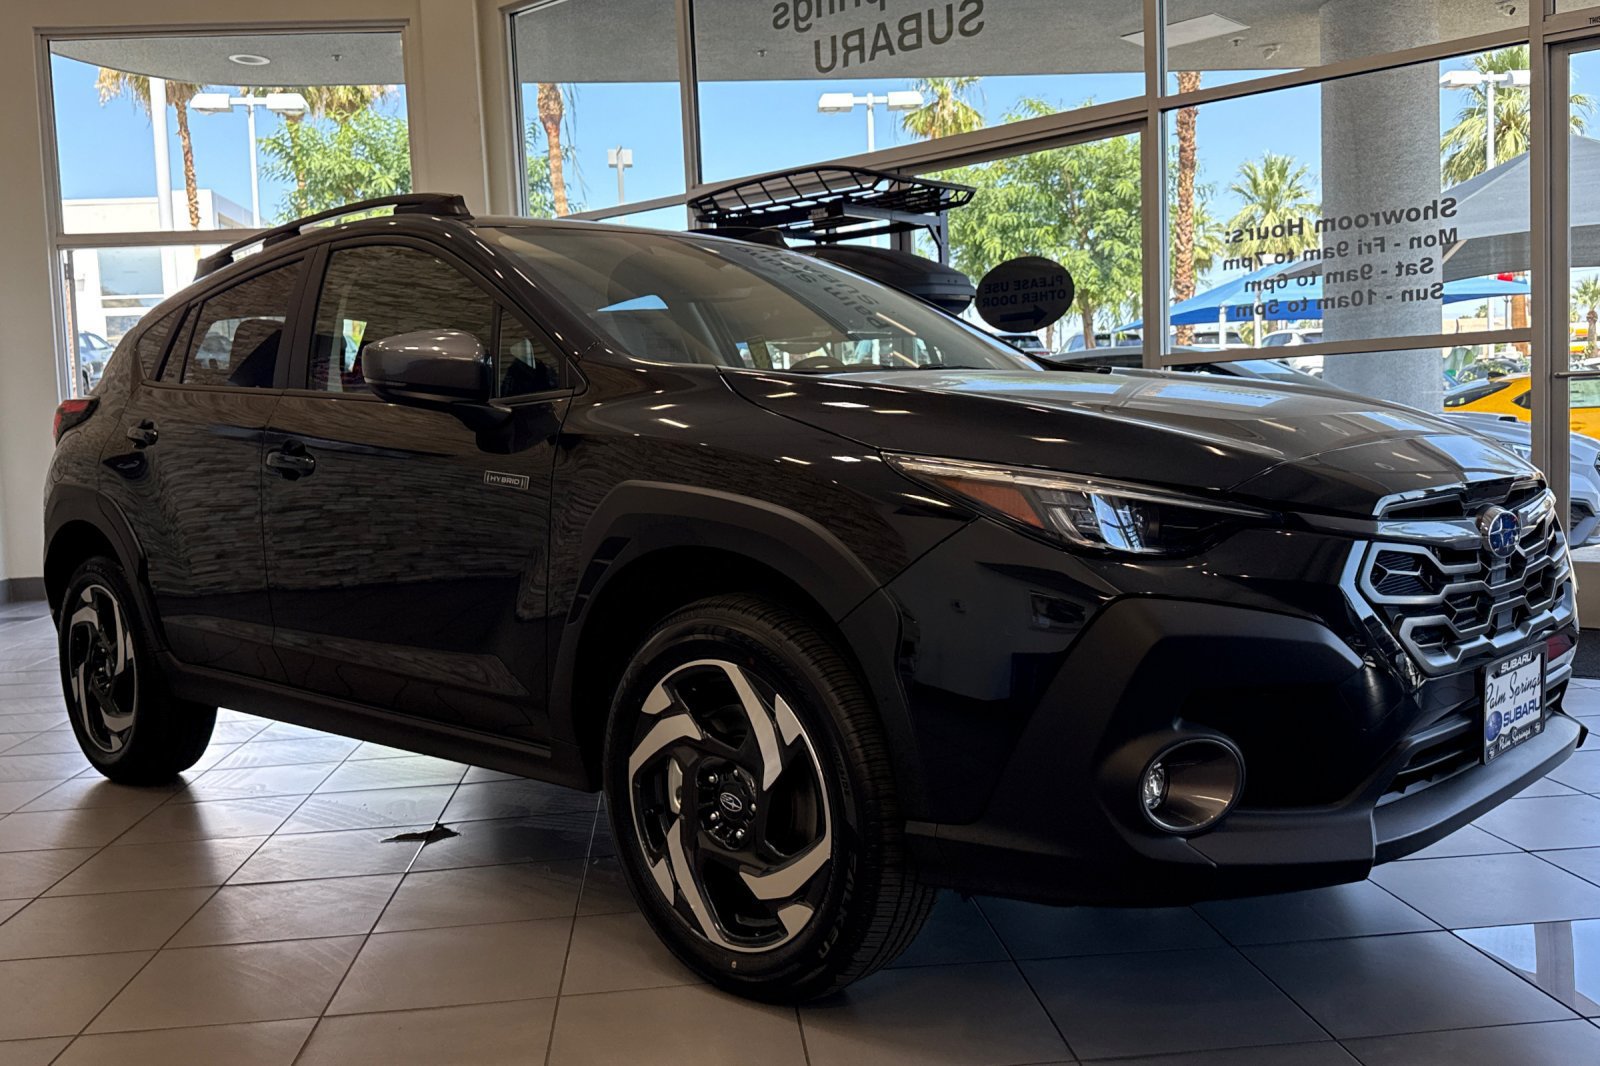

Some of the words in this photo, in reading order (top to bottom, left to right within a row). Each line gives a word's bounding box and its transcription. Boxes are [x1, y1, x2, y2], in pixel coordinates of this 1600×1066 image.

[490, 474, 520, 485] HYBRID
[1501, 653, 1532, 673] SUBARU
[1486, 683, 1505, 709] Palm
[1509, 672, 1541, 705] Springs
[1503, 698, 1541, 727] SUBARU
